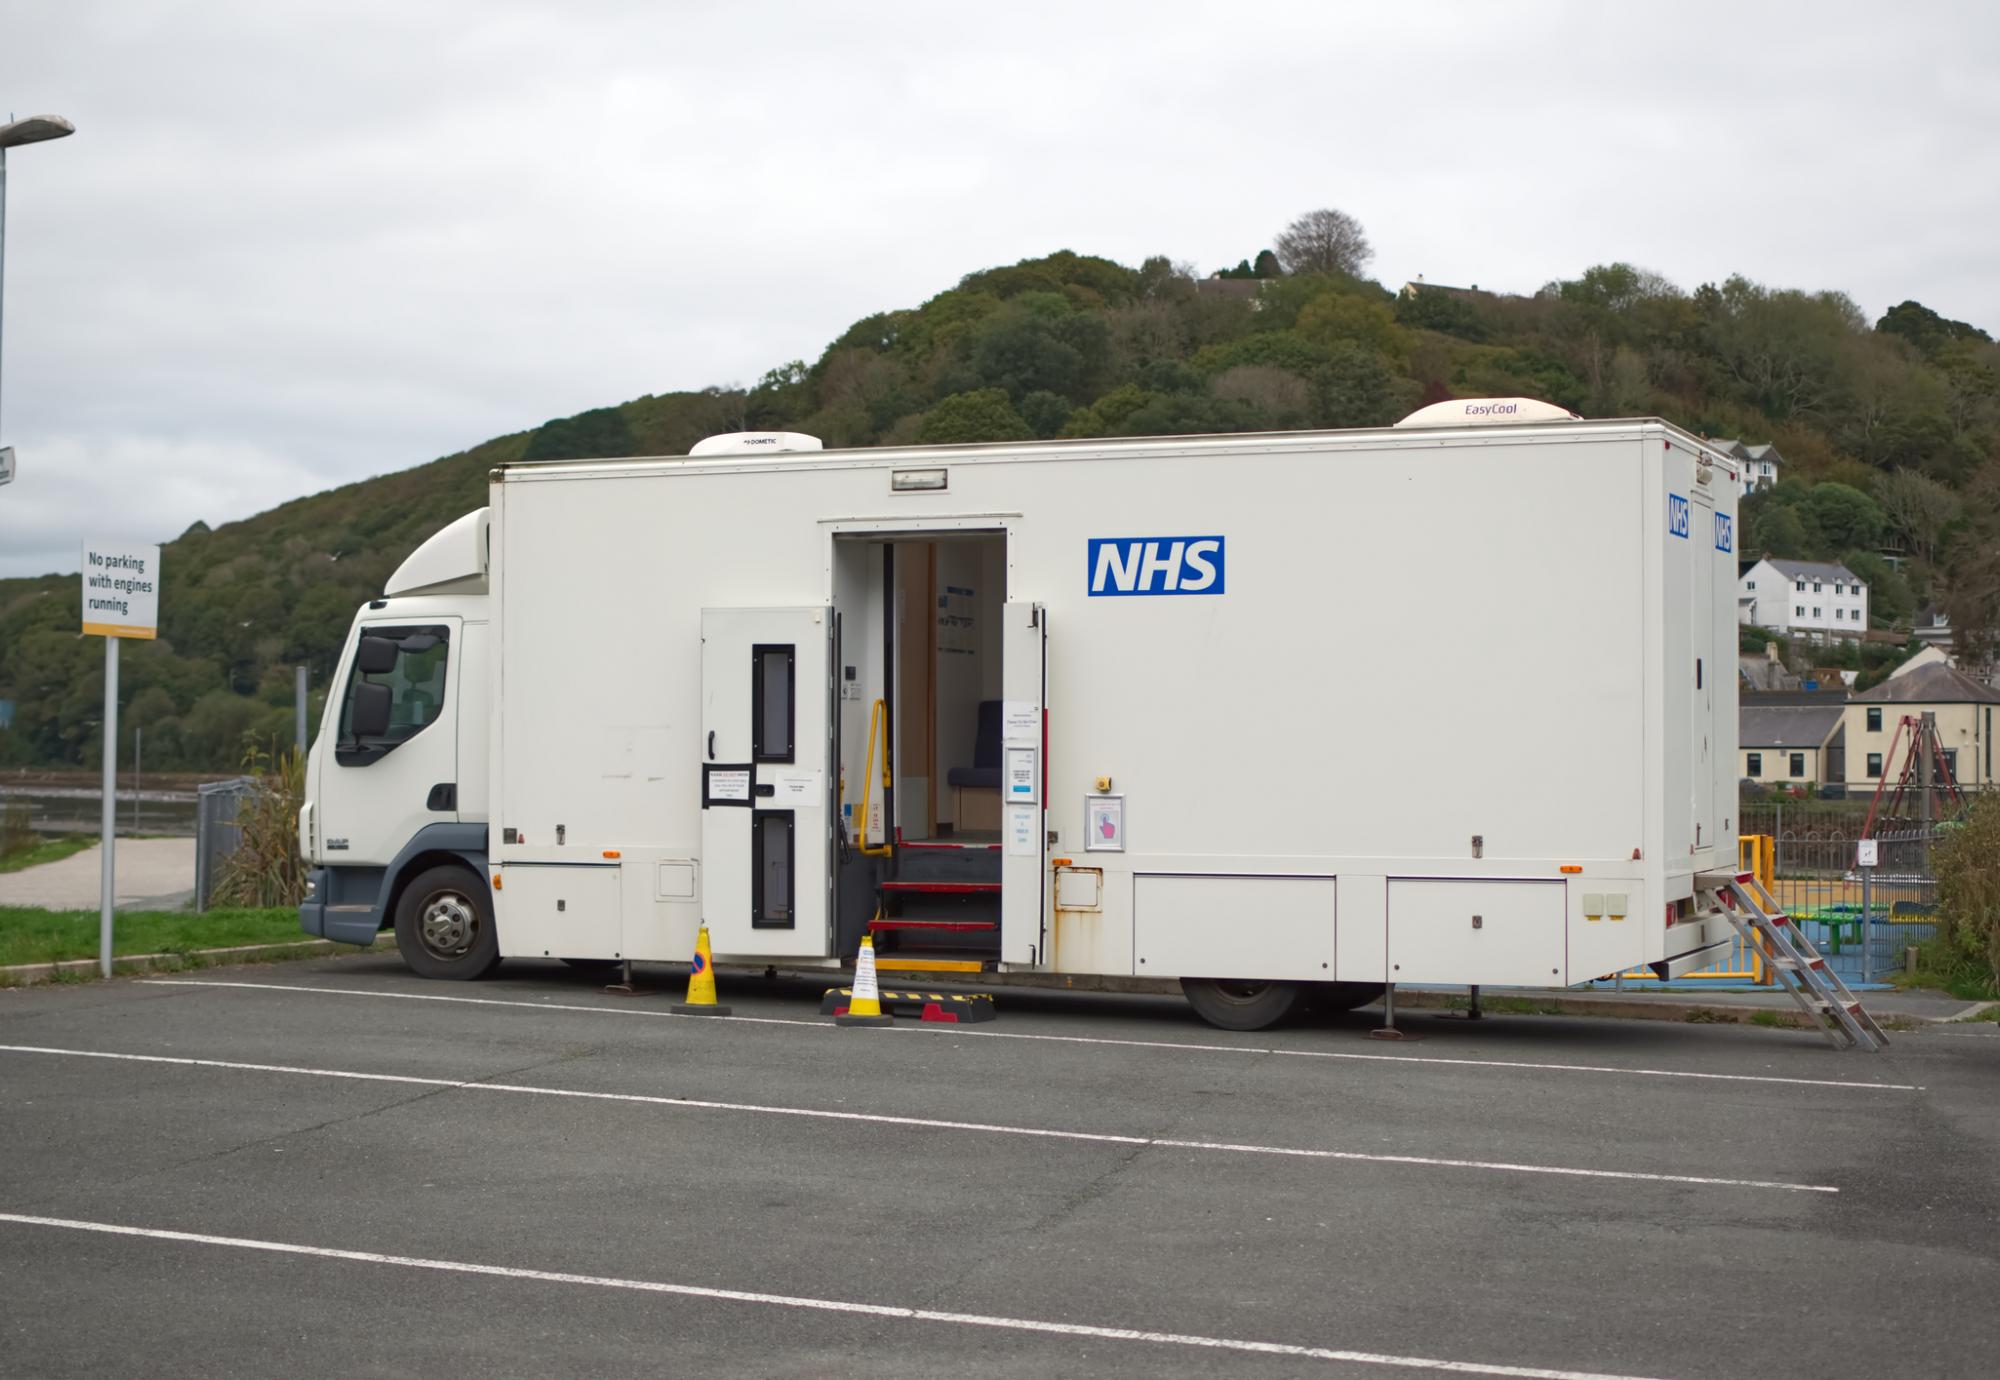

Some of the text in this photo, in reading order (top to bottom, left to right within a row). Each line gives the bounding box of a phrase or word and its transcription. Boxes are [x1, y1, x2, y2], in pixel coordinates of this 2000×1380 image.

[1465, 403, 1517, 415] EasyCool
[1669, 496, 1688, 536] NHS
[1715, 514, 1731, 550] NHS
[89, 552, 144, 574] No parking
[1091, 540, 1220, 591] NHS
[89, 573, 152, 594] with engines
[89, 597, 128, 615] running
